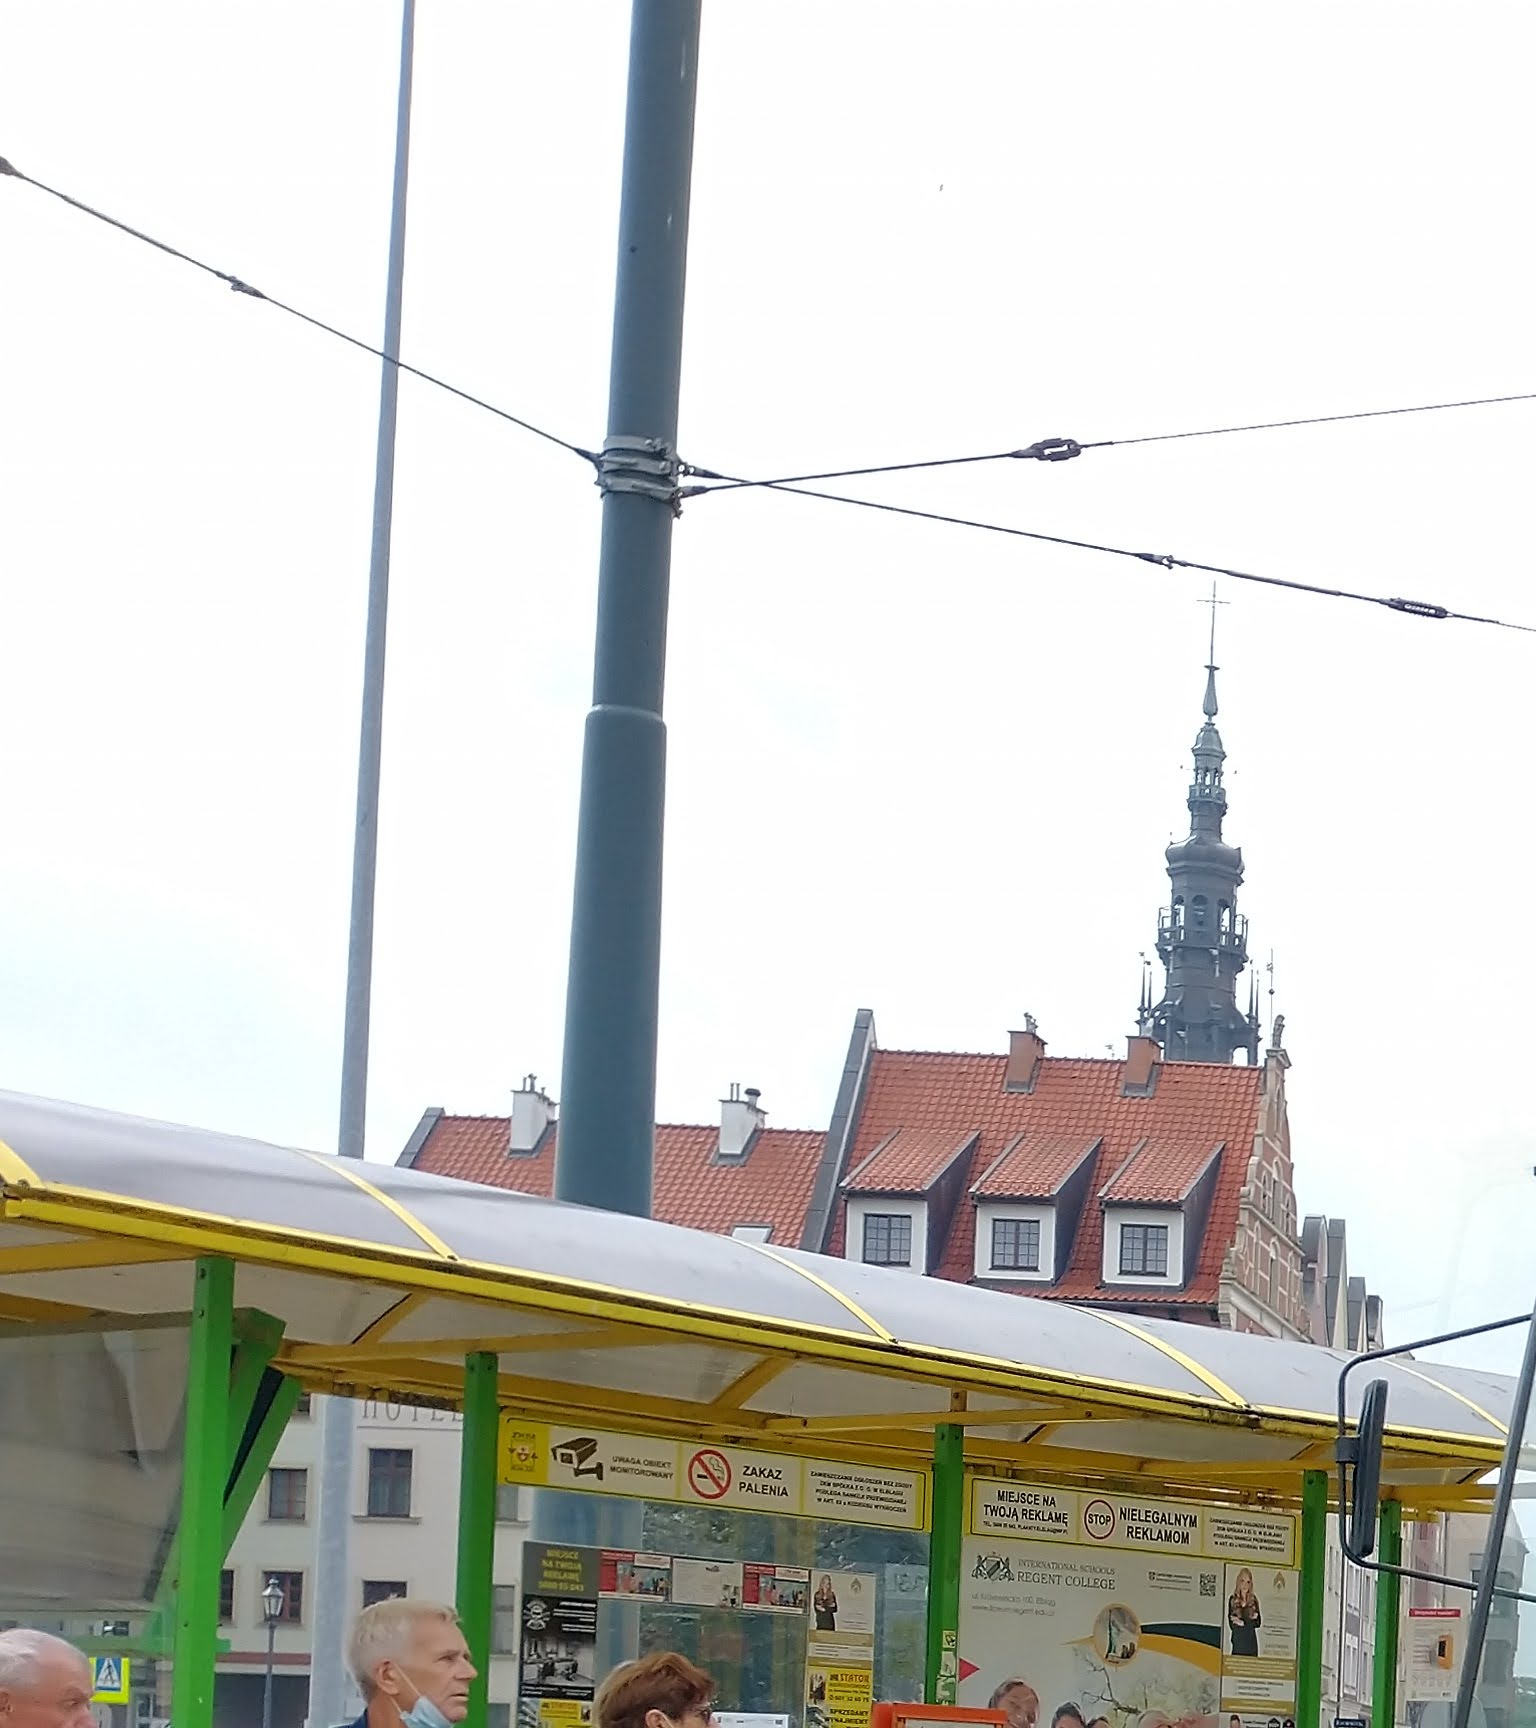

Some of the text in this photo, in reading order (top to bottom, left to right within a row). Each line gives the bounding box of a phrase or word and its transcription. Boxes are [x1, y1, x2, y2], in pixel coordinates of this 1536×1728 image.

[612, 1456, 641, 1465] UWAGA
[743, 1465, 782, 1480] ZAKAZ
[738, 1482, 788, 1497] PALENIA
[997, 1490, 1056, 1507] MIEJSCE NA
[984, 1504, 1068, 1527] TWOJĄ REKLAMĘ
[1087, 1513, 1112, 1526] STOP
[1119, 1507, 1198, 1528] NIELEGALNYM
[1126, 1526, 1190, 1544] REKLAMOM
[1018, 1559, 1115, 1575] INTERNATIONAL SCHOOLS
[1017, 1571, 1115, 1590] REGENT COLLEGE
